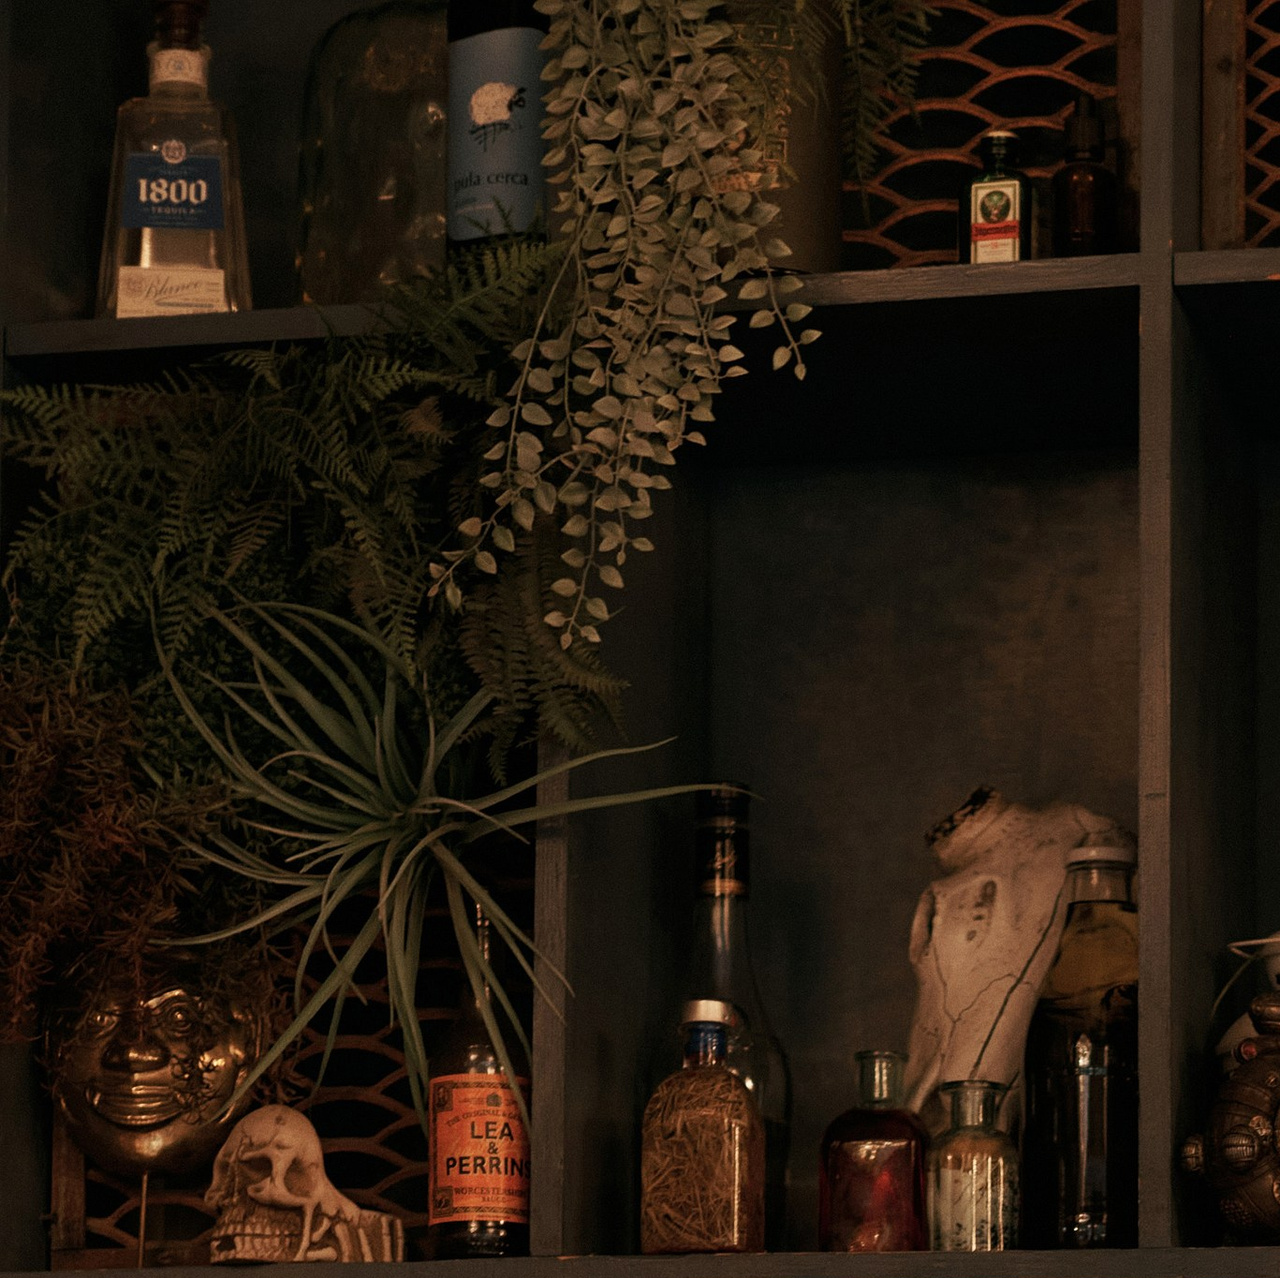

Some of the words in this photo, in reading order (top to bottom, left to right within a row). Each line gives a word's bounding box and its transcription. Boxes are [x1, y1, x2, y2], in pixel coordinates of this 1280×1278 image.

[487, 173, 528, 186] cerca
[138, 178, 208, 205] 1800
[151, 206, 196, 215] TEQUILA
[471, 1121, 514, 1141] LEA
[487, 1142, 499, 1154] &
[446, 1156, 531, 1179] PERRINS
